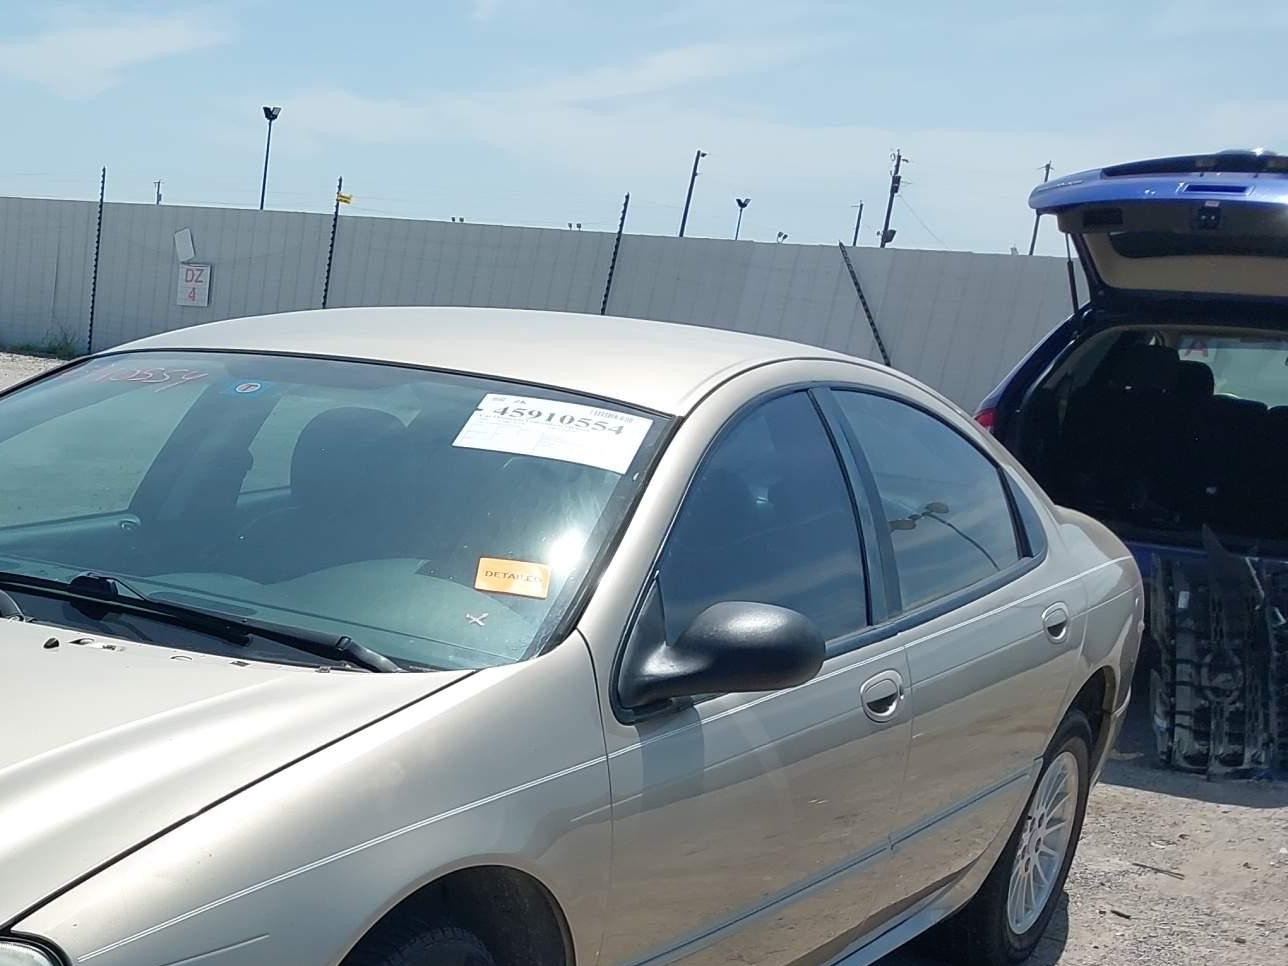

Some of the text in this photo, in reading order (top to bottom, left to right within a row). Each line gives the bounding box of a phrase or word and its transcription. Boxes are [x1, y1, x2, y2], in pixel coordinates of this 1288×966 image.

[185, 269, 204, 283] DZ
[188, 287, 196, 302] 4
[492, 406, 625, 435] 45910554
